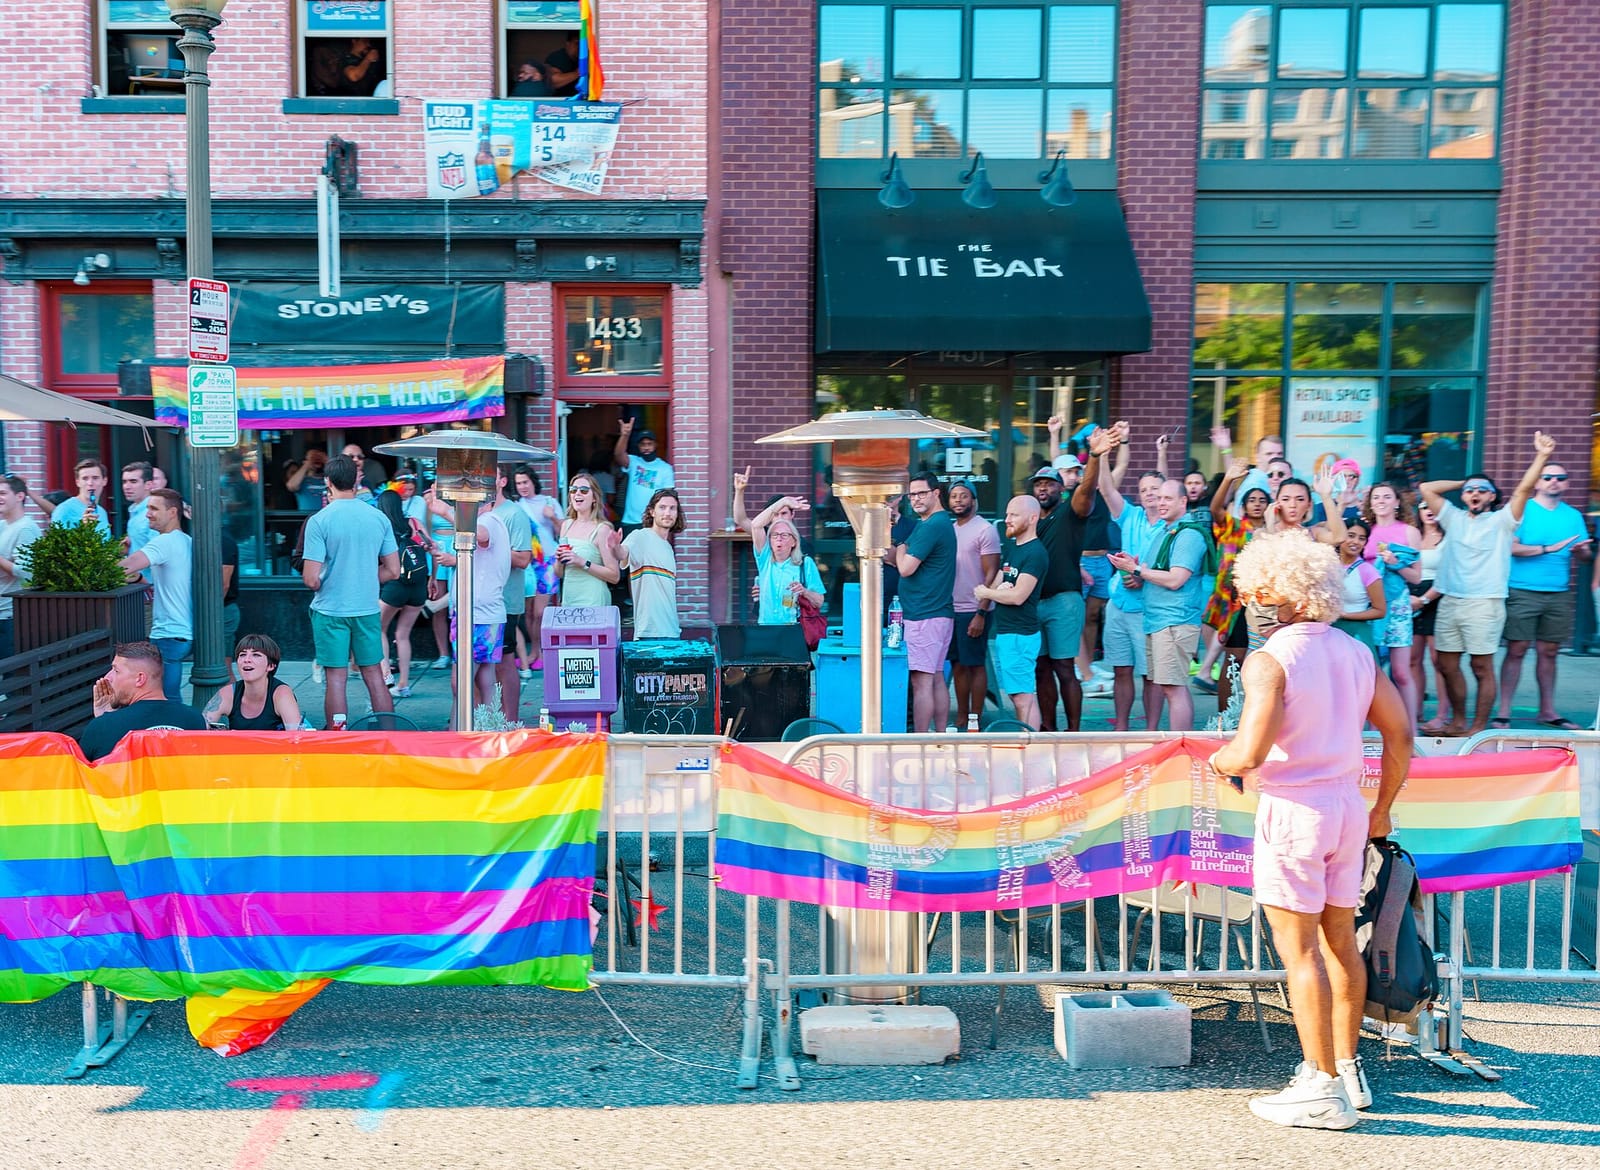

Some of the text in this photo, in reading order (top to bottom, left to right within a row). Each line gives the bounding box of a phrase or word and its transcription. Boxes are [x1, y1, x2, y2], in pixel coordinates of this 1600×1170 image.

[433, 106, 466, 116] BUD
[429, 117, 472, 128] LIGHT
[442, 168, 465, 186] NFL
[958, 244, 993, 252] THE
[886, 256, 1064, 278] TIE BAR
[192, 290, 200, 304] 2
[202, 292, 219, 300] HOUR
[278, 294, 430, 318] STONEY'S
[586, 318, 642, 338] 1433
[193, 393, 200, 404] 2
[280, 384, 380, 410] ALWAYS
[388, 379, 456, 407] WINS
[1296, 388, 1372, 401] RETAIL SPACE
[1301, 410, 1363, 423] AVAILABLE
[1190, 828, 1214, 842] god
[1190, 840, 1218, 850] sent
[1189, 848, 1254, 866] captivating
